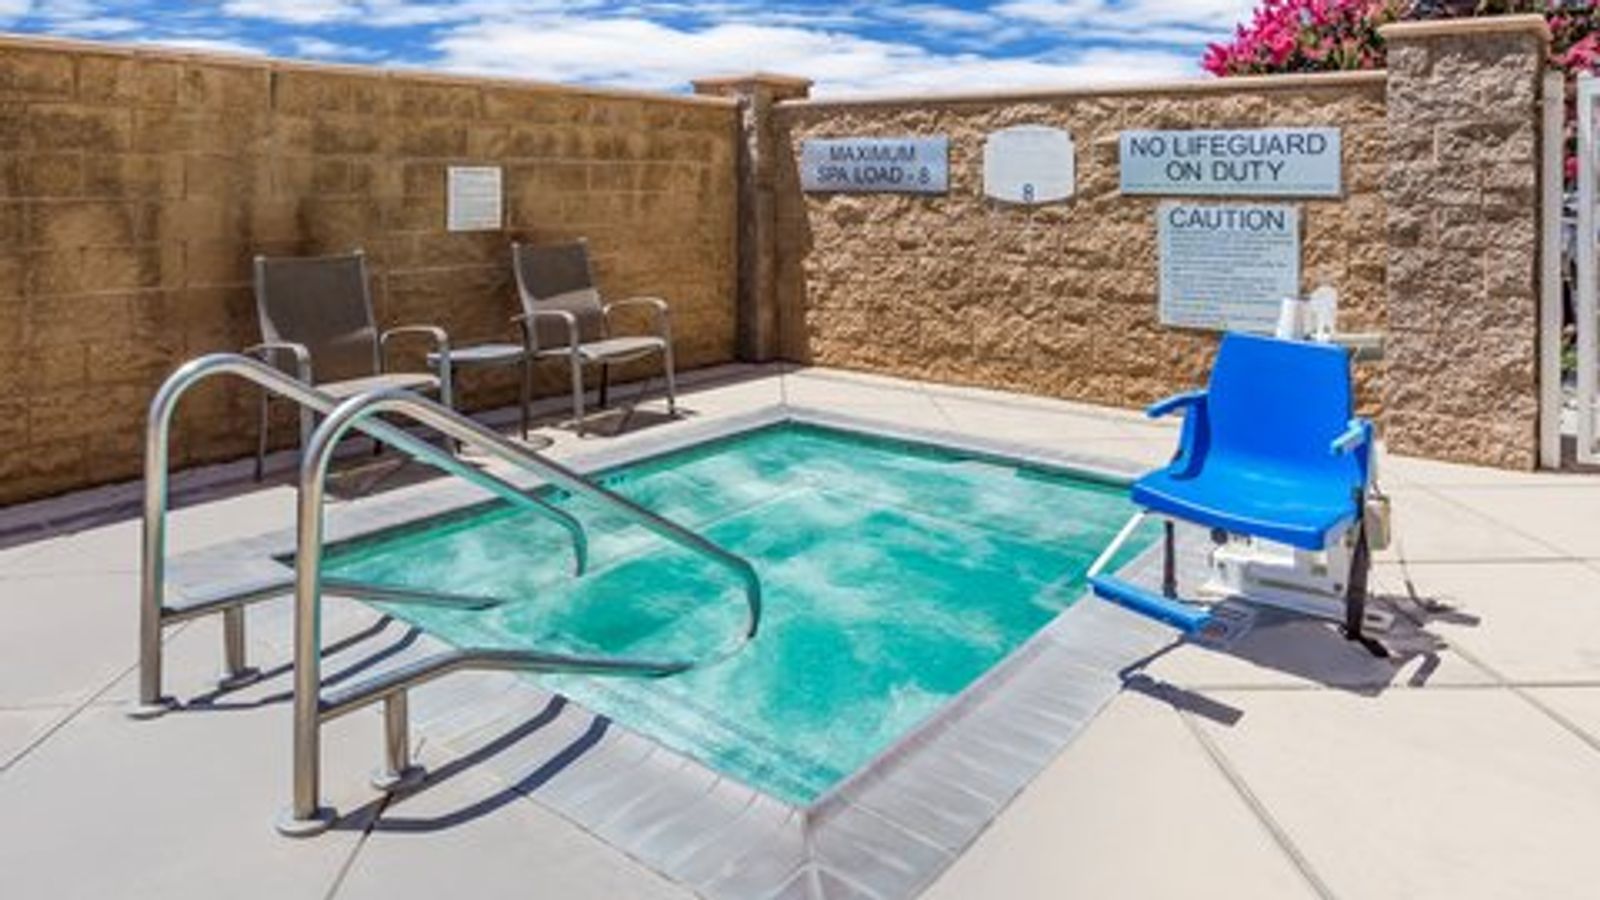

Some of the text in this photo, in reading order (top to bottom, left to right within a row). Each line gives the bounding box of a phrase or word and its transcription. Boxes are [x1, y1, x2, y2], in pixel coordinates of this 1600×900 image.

[1129, 133, 1328, 158] NO LIFEGUARD
[816, 165, 850, 183] SPA
[853, 166, 905, 184] LOAD
[1165, 160, 1285, 182] ON DUTY
[1169, 206, 1286, 231] CAUTION
